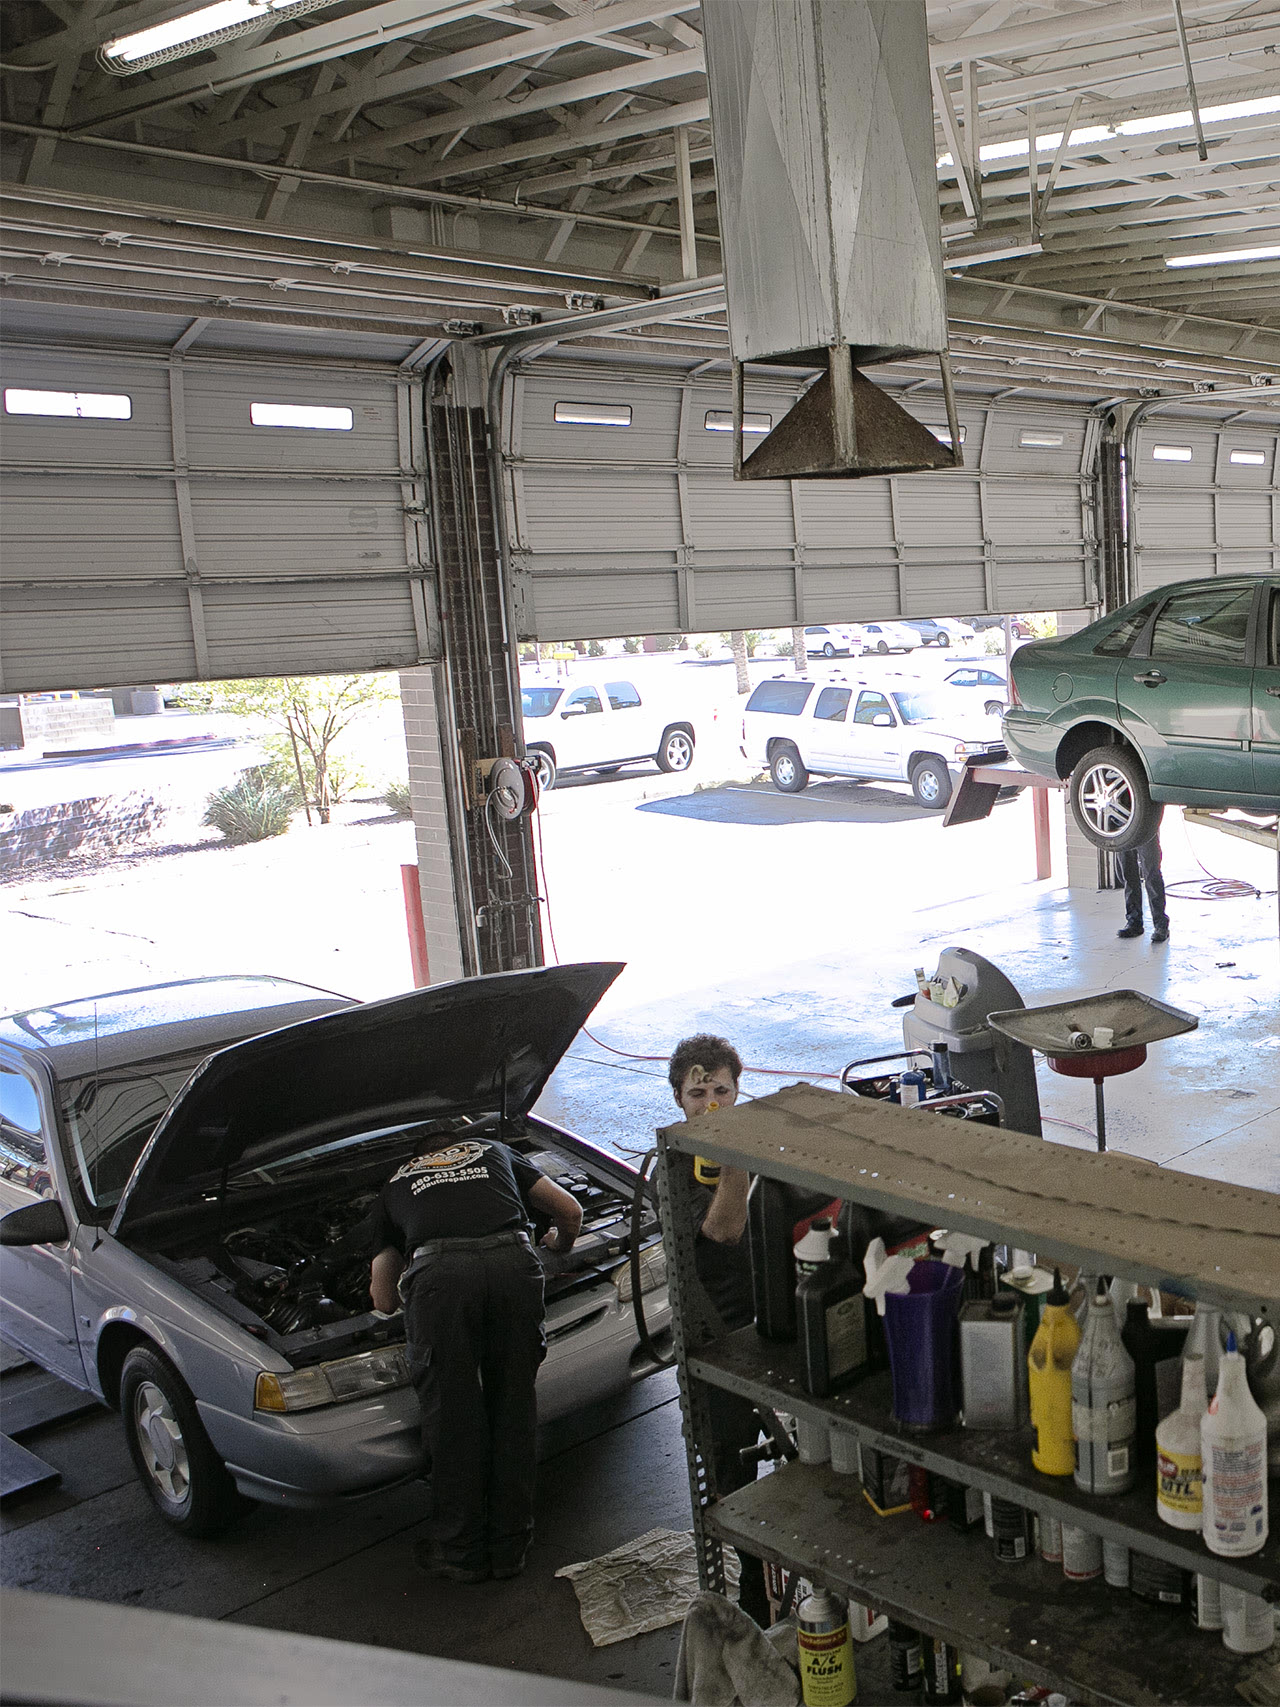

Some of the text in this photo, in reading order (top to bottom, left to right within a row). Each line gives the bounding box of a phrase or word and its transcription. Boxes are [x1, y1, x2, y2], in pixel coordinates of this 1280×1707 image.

[410, 1166, 488, 1190] 480-633-5505
[412, 1173, 490, 1196] radautorepair.com
[806, 1662, 843, 1676] FLUSH
[812, 1655, 836, 1669] A/C
